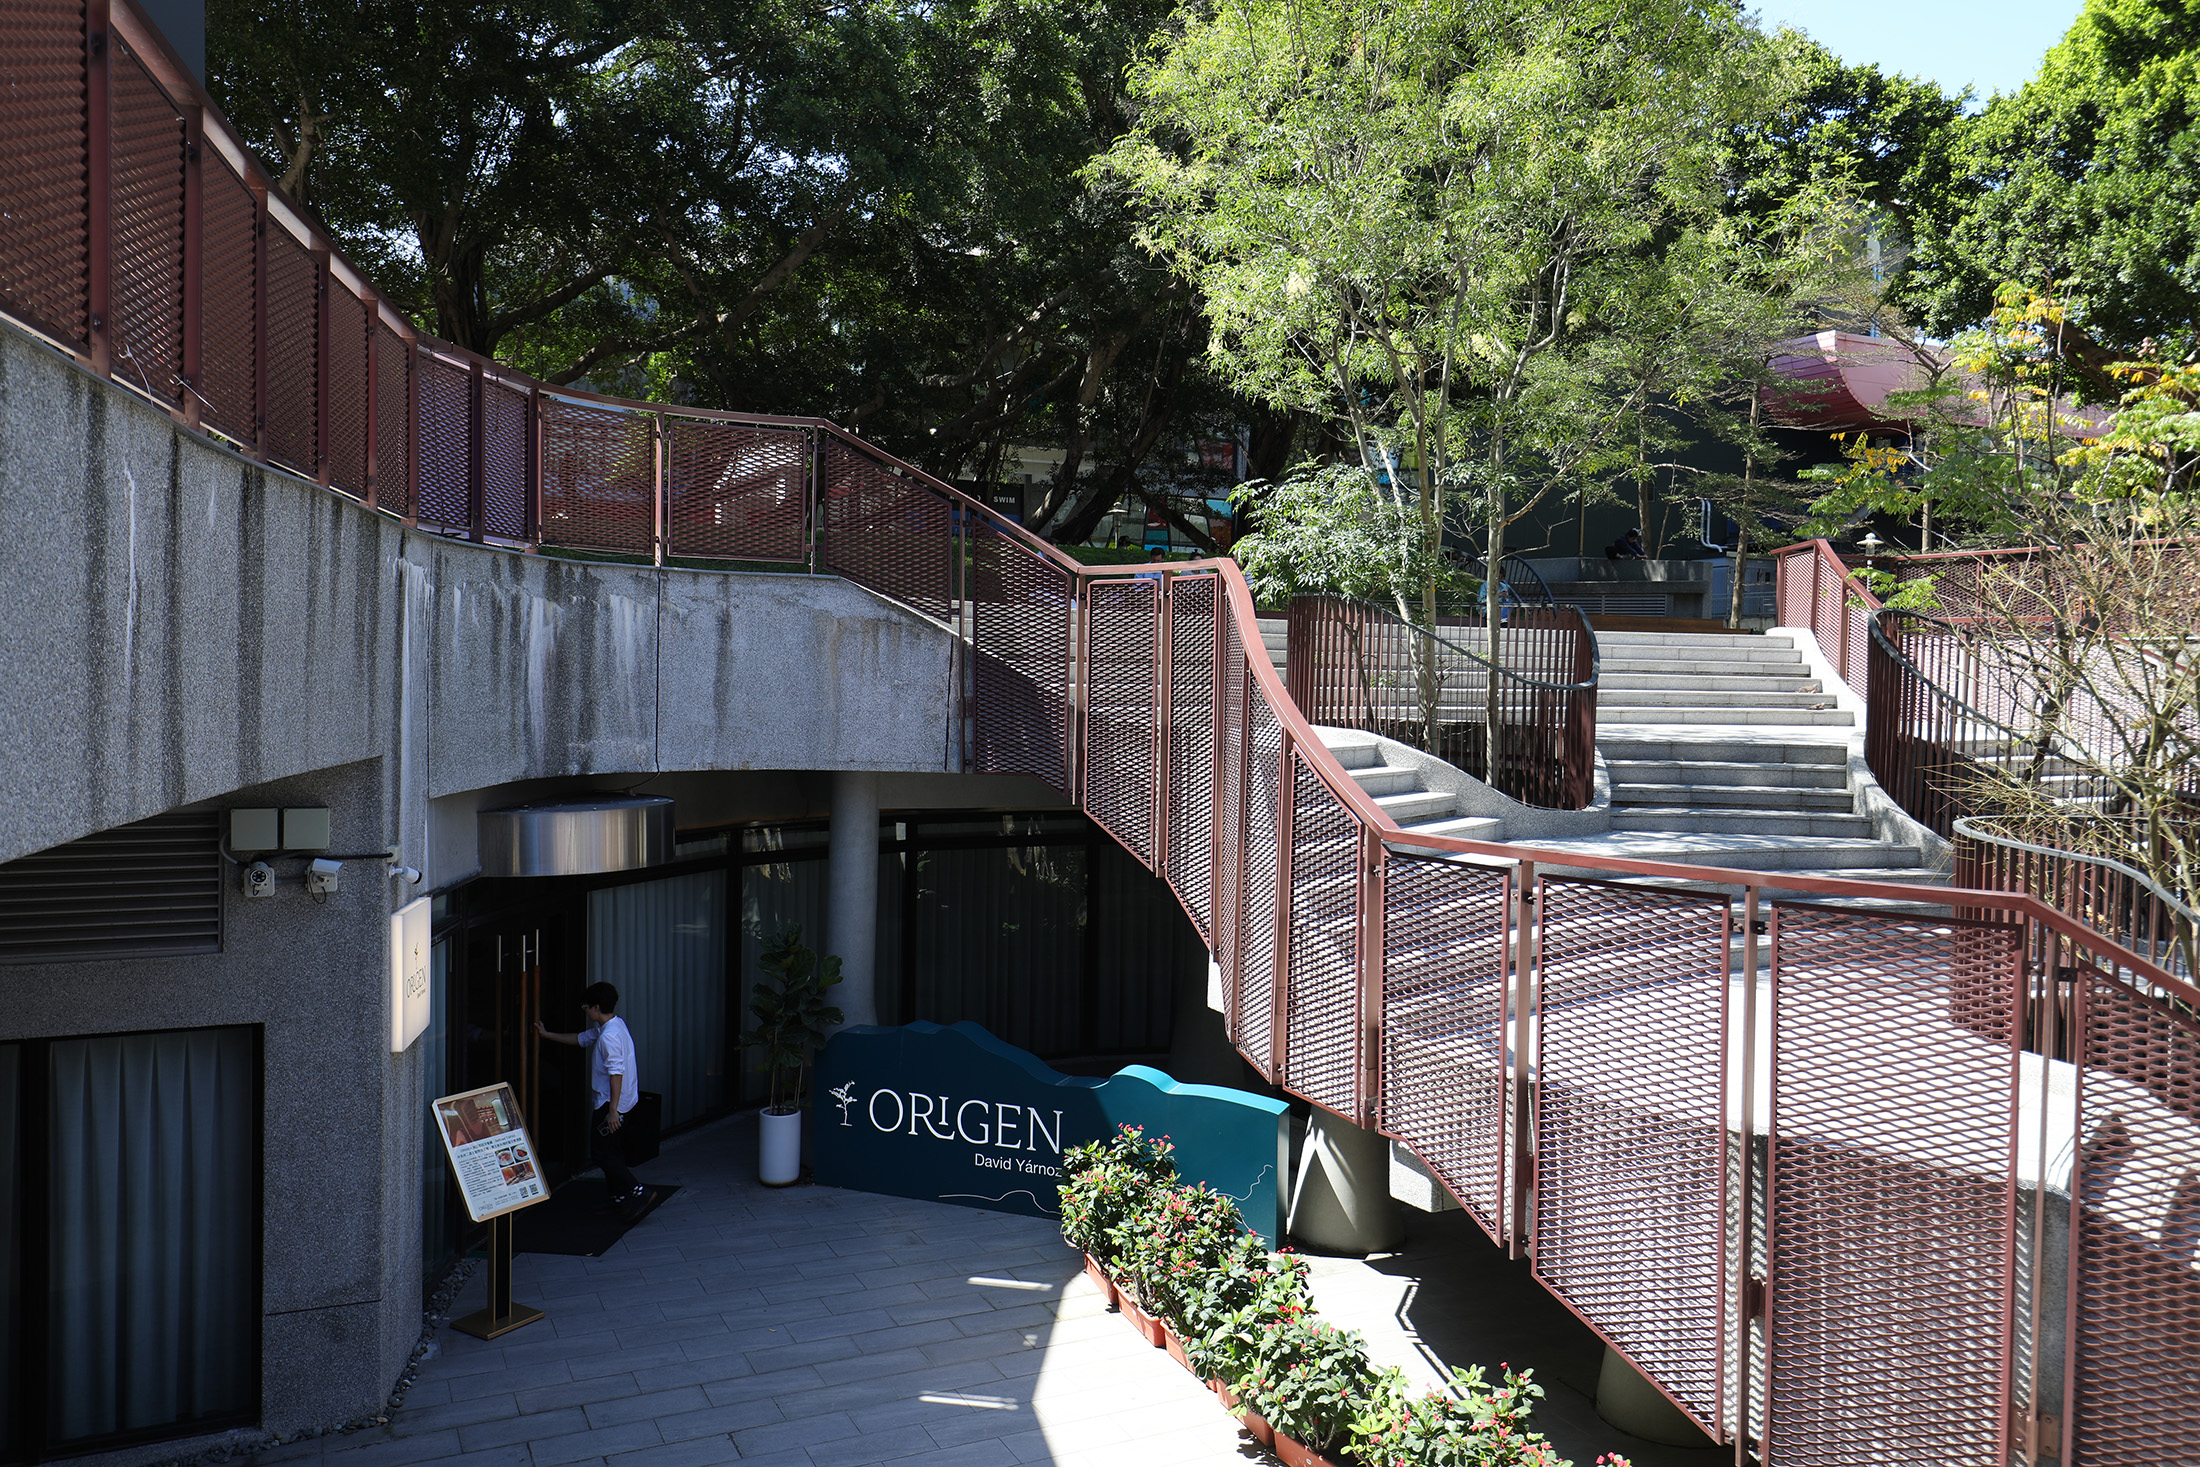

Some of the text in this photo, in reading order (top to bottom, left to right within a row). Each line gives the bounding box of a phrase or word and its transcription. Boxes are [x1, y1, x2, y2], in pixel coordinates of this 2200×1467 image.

[993, 496, 1016, 504] SWIM
[869, 1088, 1064, 1154] ORIGEN
[974, 1153, 1012, 1171] David
